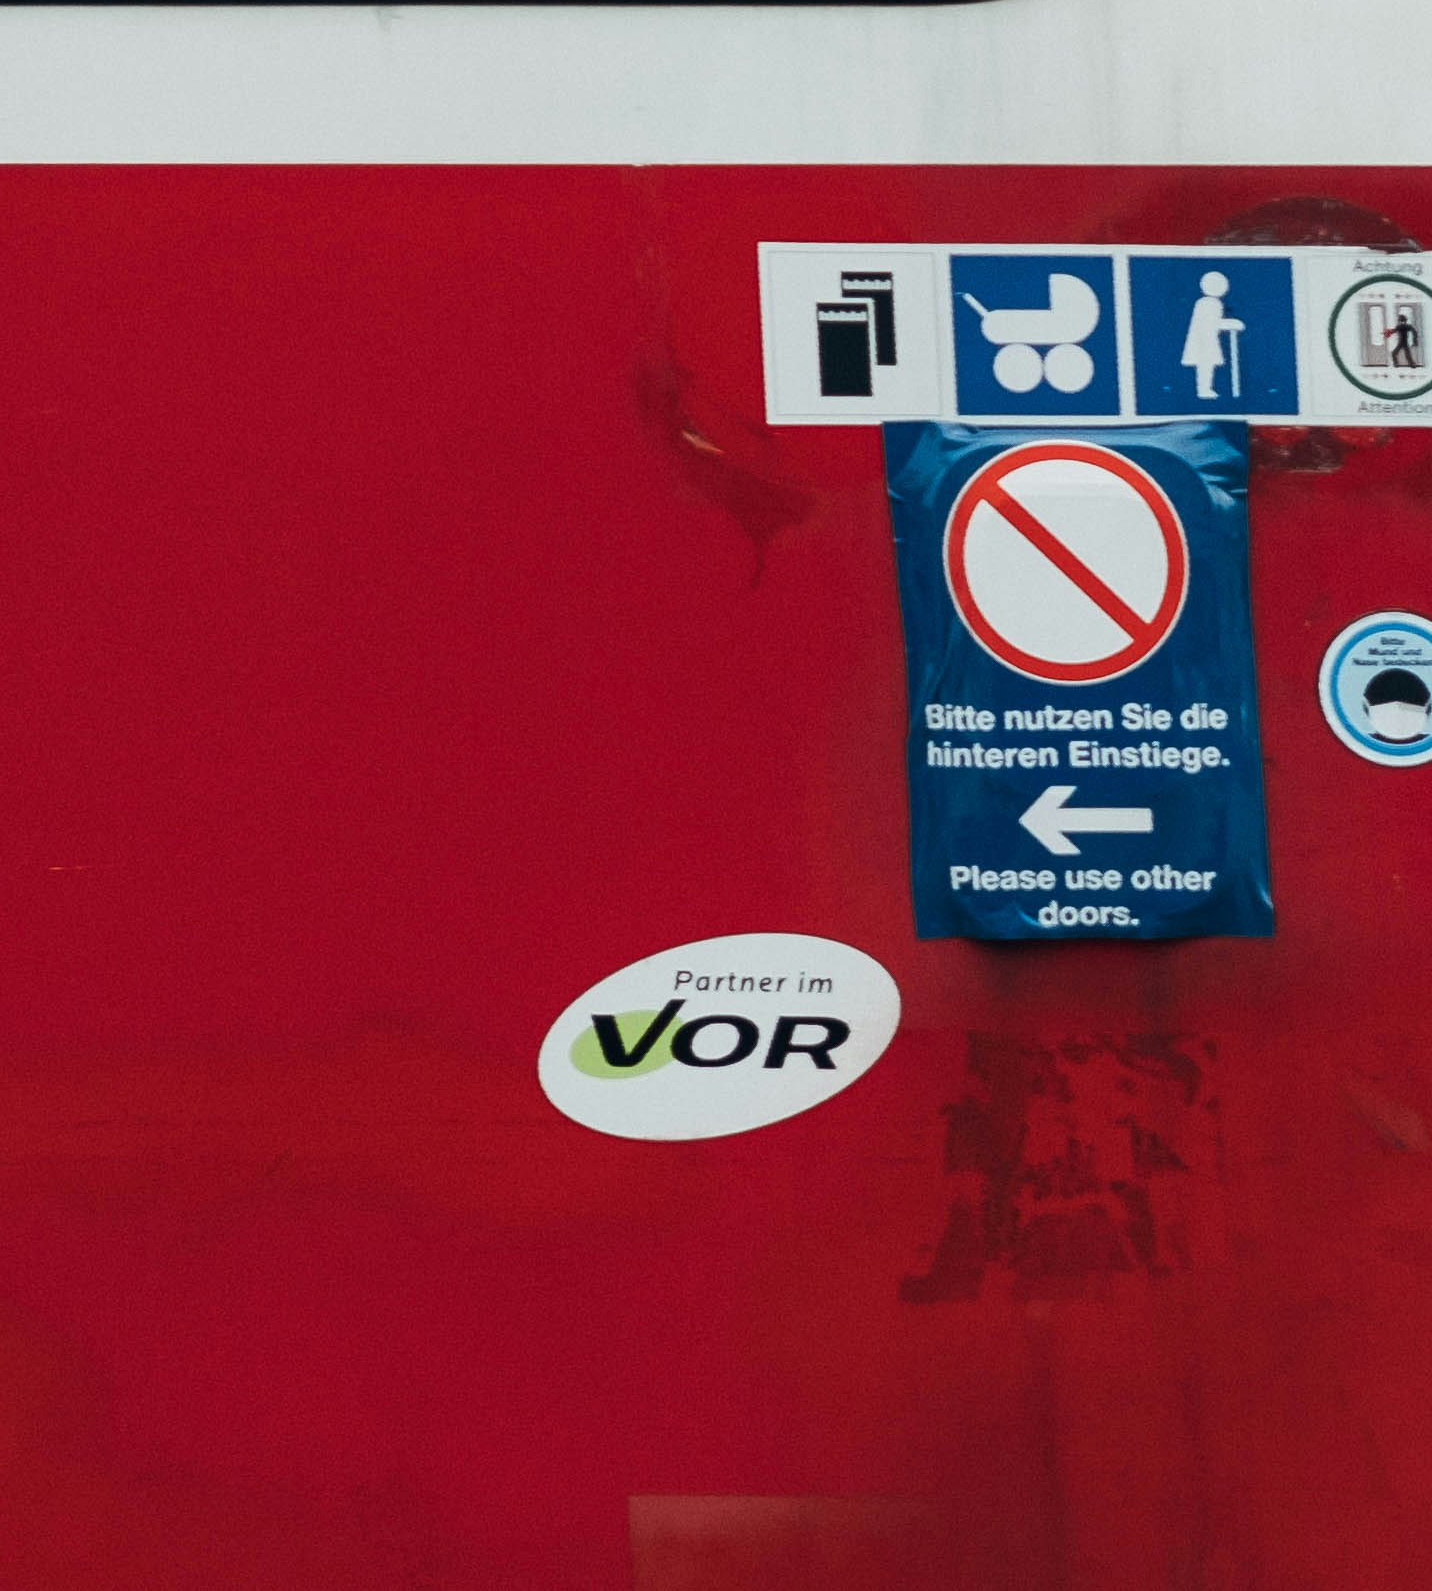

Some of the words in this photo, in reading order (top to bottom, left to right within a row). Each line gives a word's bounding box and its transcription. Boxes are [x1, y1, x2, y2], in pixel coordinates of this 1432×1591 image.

[1352, 259, 1423, 276] Achtung
[924, 704, 995, 732] Bitte
[1003, 706, 1114, 732] nutzen
[1121, 703, 1171, 731] Sie
[1179, 703, 1229, 730] die
[926, 741, 1059, 768] hinteren
[1069, 740, 1231, 774] Einstiege.
[949, 865, 1057, 893] Please
[1064, 871, 1122, 893] use
[1130, 864, 1217, 893] other
[1037, 900, 1141, 928] doors.
[674, 971, 786, 994] Partner
[798, 972, 833, 994] im
[591, 998, 851, 1070] VOR
